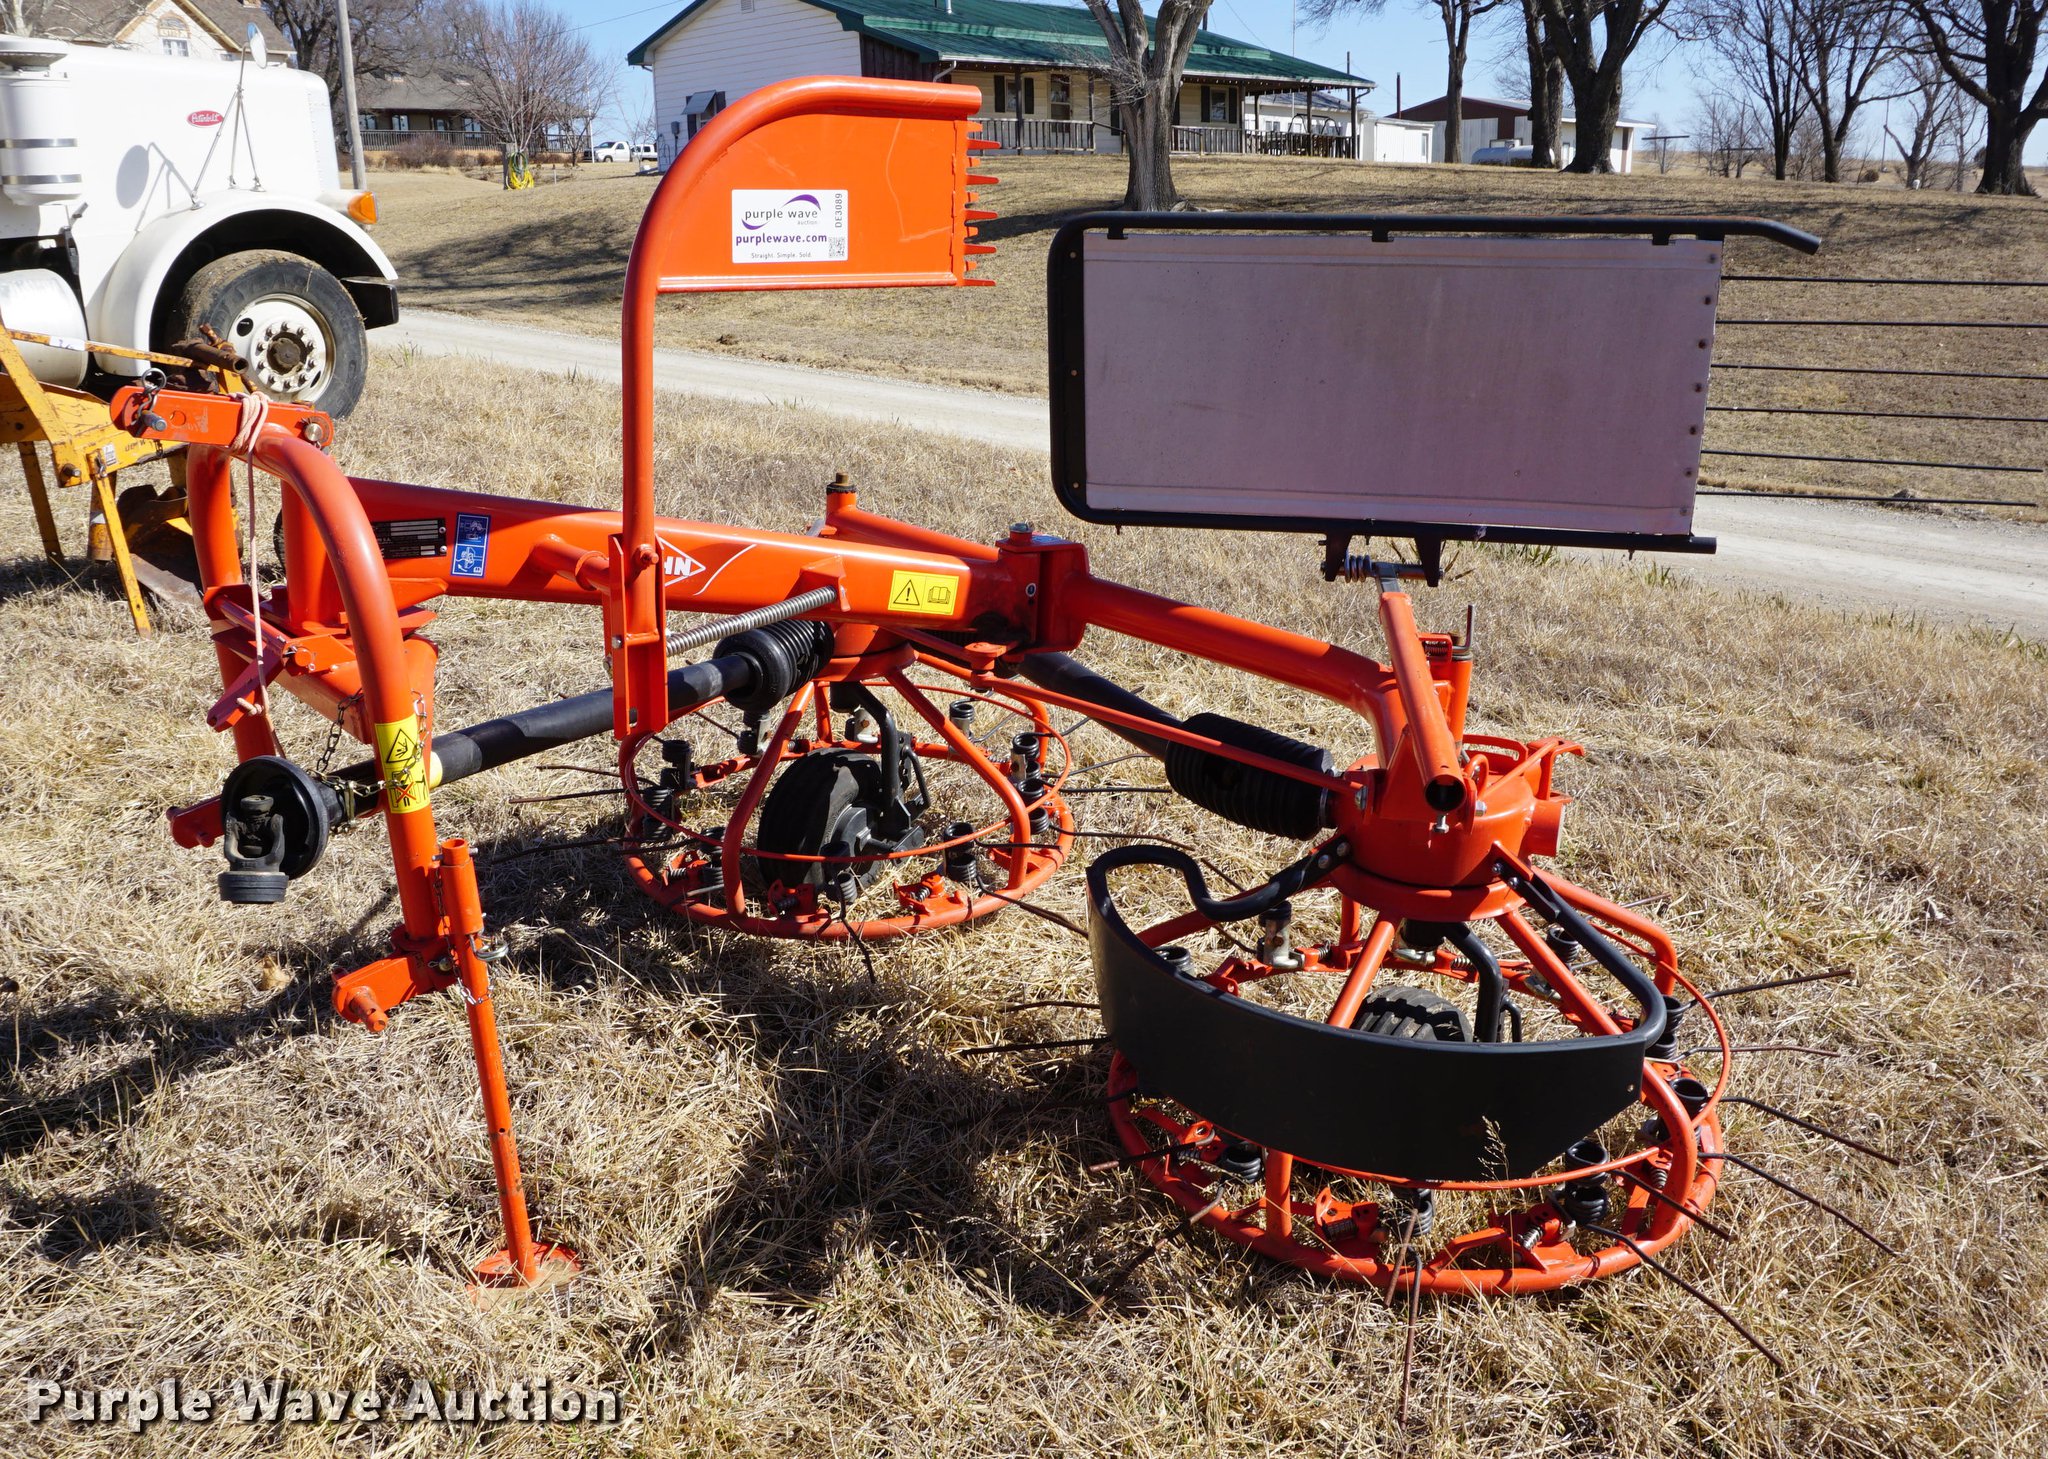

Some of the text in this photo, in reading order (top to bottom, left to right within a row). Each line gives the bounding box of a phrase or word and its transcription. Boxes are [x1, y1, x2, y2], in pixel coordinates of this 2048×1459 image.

[745, 208, 818, 221] purple wave
[834, 193, 843, 228] DE3089
[736, 233, 827, 246] purplewave.com
